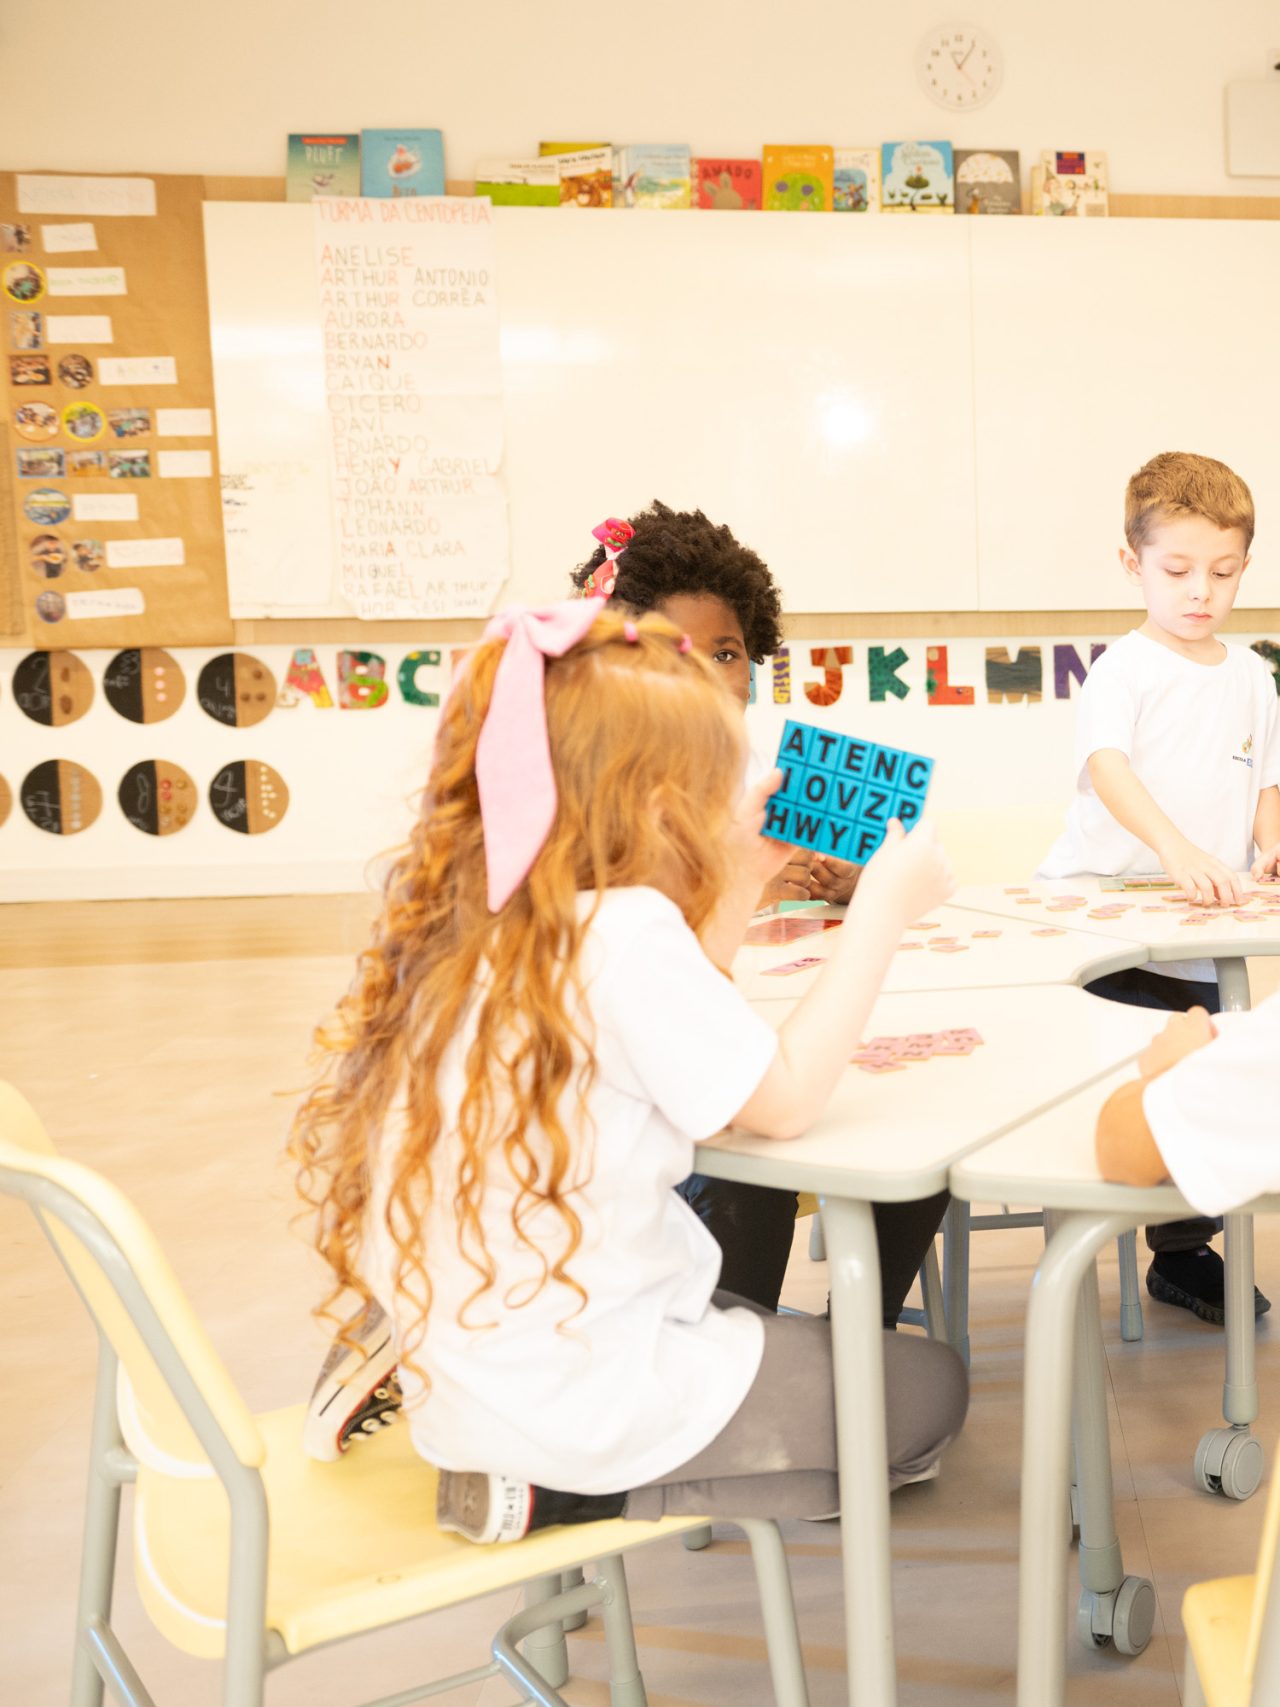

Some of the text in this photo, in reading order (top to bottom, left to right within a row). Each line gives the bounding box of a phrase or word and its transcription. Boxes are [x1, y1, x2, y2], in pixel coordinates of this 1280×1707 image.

[379, 201, 401, 223] DA
[320, 243, 414, 267] ANELISE
[320, 267, 490, 287] ARTHUR ANTONIO
[321, 289, 400, 307] ARTHUR
[324, 309, 405, 329] AURORA
[325, 331, 429, 352] BERNARDO
[325, 352, 391, 371] BRYAN
[325, 372, 416, 392] CAIQUE
[332, 415, 385, 434] DAVI
[333, 434, 429, 455] EDUARDO
[336, 453, 401, 477] HENRY
[408, 478, 475, 495] ARTHUR
[336, 496, 424, 517] JOHANN
[341, 517, 442, 539] LEONARDO
[406, 539, 465, 560] CLARA
